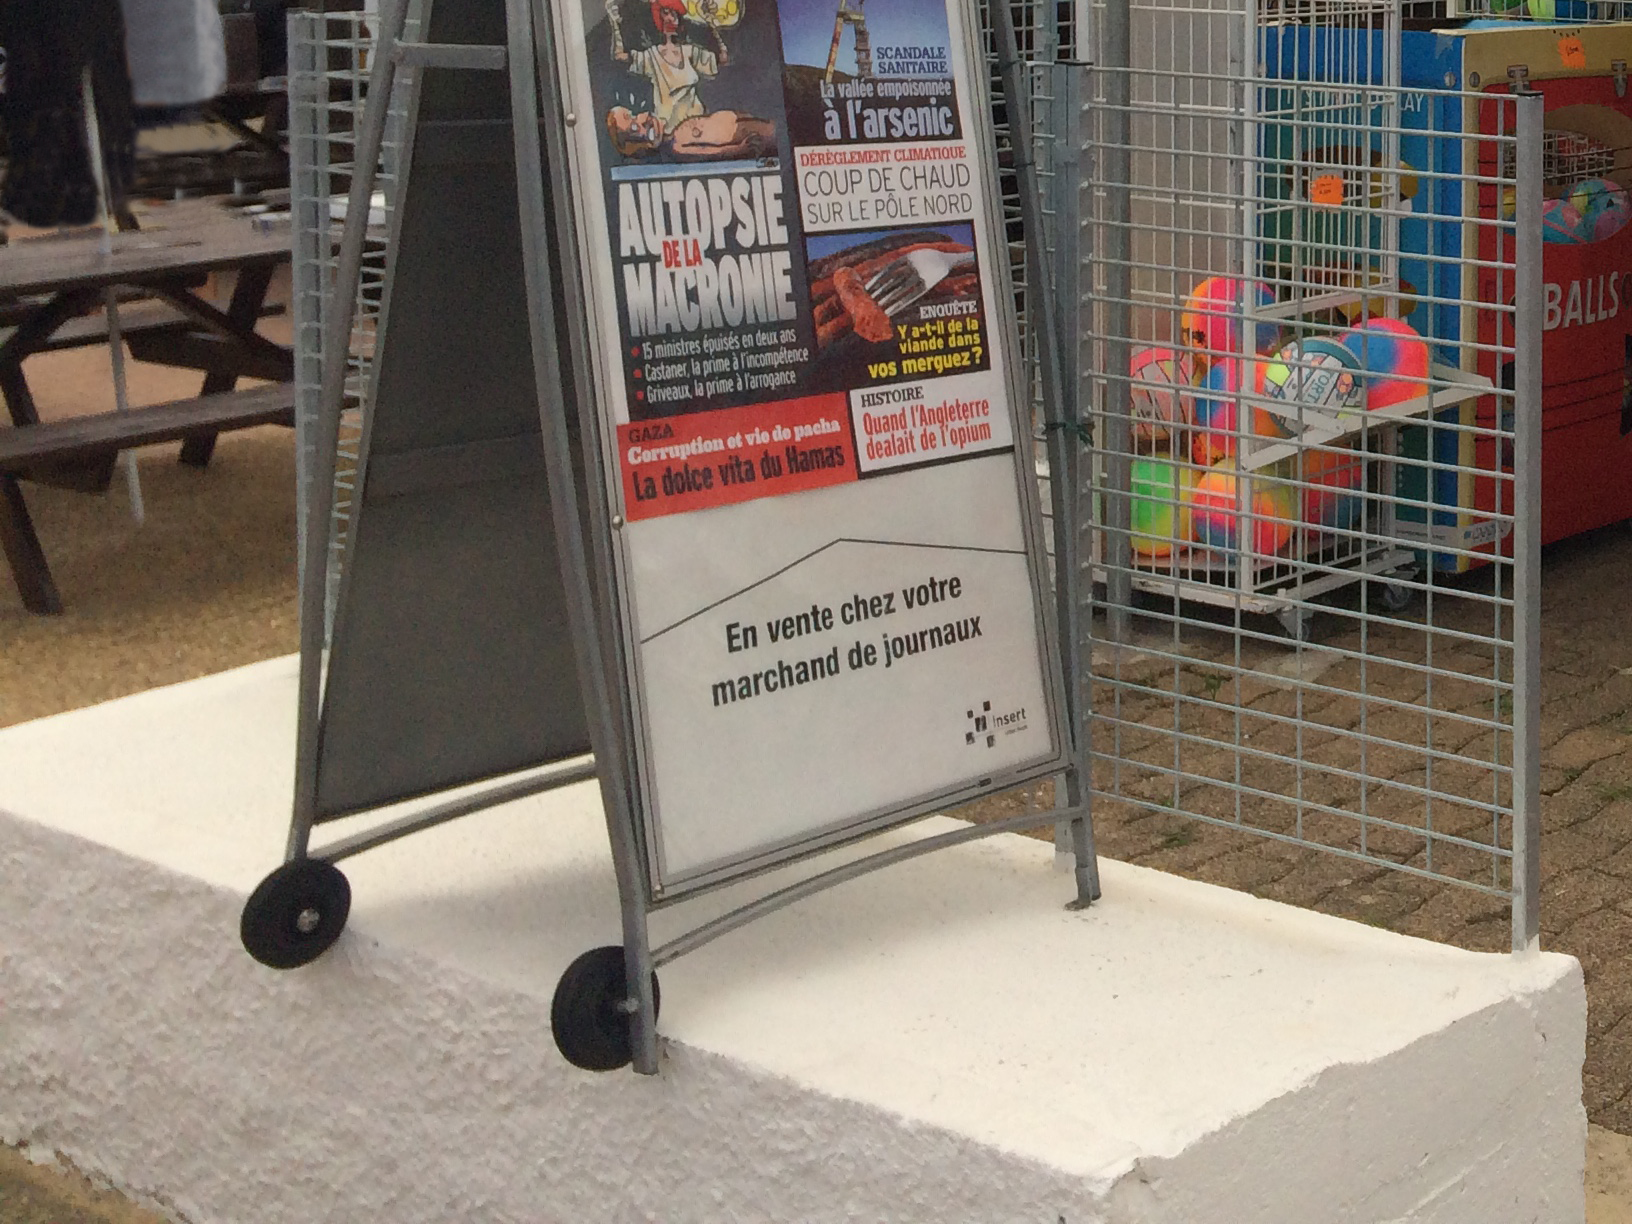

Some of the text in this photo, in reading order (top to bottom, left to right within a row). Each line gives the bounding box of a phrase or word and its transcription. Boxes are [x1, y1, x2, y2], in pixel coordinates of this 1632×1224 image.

[876, 46, 946, 62] SCANDALE
[878, 59, 948, 75] SANITAIRE
[820, 78, 952, 101] La vallée empoisonnée
[824, 100, 955, 141] à l'arsenic
[799, 145, 967, 168] DÉRÈGLEMENT CLIMATIQUE
[804, 163, 971, 198] COUP DE CHAUD
[617, 175, 790, 258] AUTOPSIE
[807, 192, 973, 225] SUR LE PÔLE NORD
[661, 238, 703, 269] DE LA
[623, 250, 798, 338] MACRONIE
[919, 299, 978, 320] ENQUÊTE
[1543, 270, 1619, 331] BALLS
[642, 328, 796, 360] 15 ministres épuisés en deux ans
[897, 324, 908, 340] Y
[947, 319, 963, 333] de
[965, 317, 979, 331] la
[899, 332, 981, 355] viande dans
[644, 345, 809, 382] Castaner, la prime à l'incompétence
[867, 360, 898, 379] vos
[901, 350, 971, 374] merguez
[647, 369, 796, 403] Griveaux, la prime à l'arrogance
[860, 386, 925, 408] HISTOIRE
[862, 398, 990, 436] Quand l'Angleterre
[627, 416, 841, 466] Corruption et vie de pacha
[628, 425, 675, 444] GAZA
[865, 420, 992, 461] dealait de l'opium
[632, 442, 846, 502] La dolce vita du Hamas
[725, 574, 963, 654] En vente chez votre
[711, 615, 983, 708] marchand de journaux
[993, 707, 1027, 728] Insert
